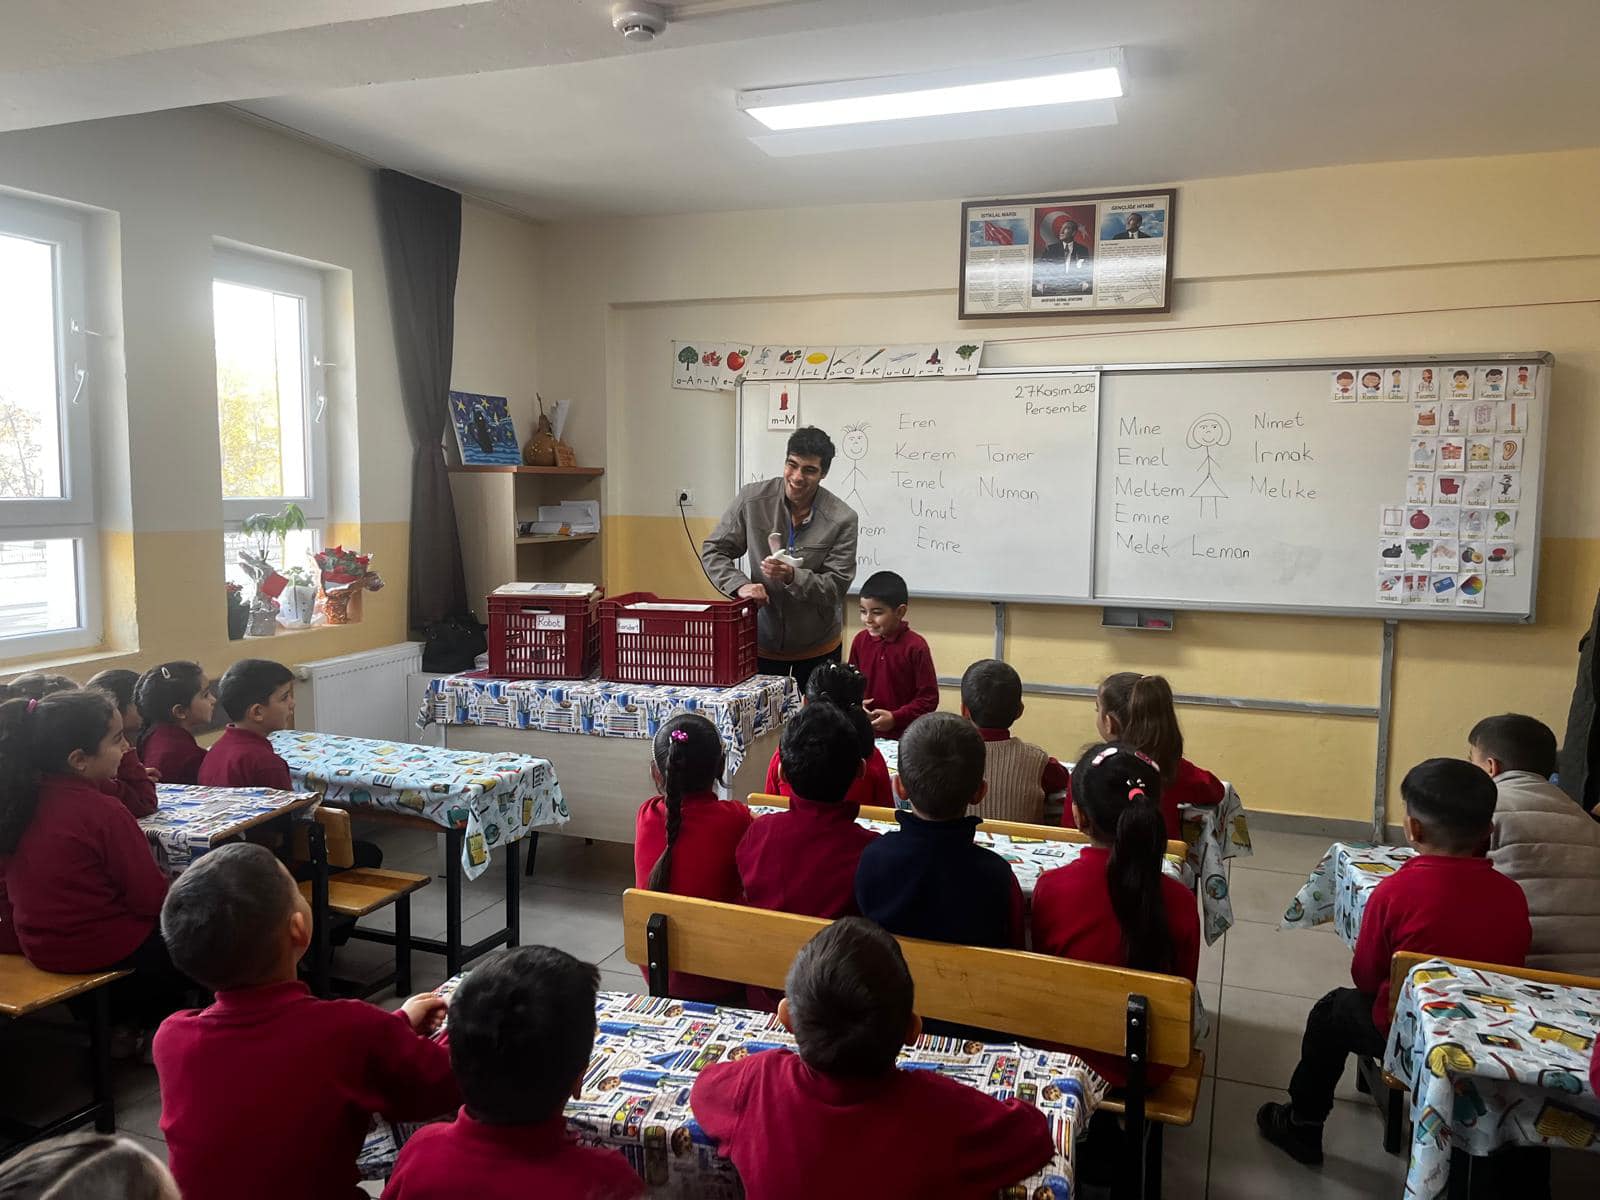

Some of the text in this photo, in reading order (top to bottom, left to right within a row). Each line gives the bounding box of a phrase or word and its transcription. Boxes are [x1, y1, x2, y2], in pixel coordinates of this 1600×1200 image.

[899, 412, 936, 429] Eren
[895, 441, 957, 461] Kerem
[976, 440, 1035, 462] Tamer
[1117, 447, 1169, 467] Emel
[1255, 440, 1315, 463] Irmak
[891, 470, 945, 489] Temel
[979, 476, 1039, 500] Numan
[1115, 475, 1185, 497] Meltem
[910, 498, 958, 520] Umut
[917, 525, 963, 553] Emre
[1192, 534, 1250, 559] Leman
